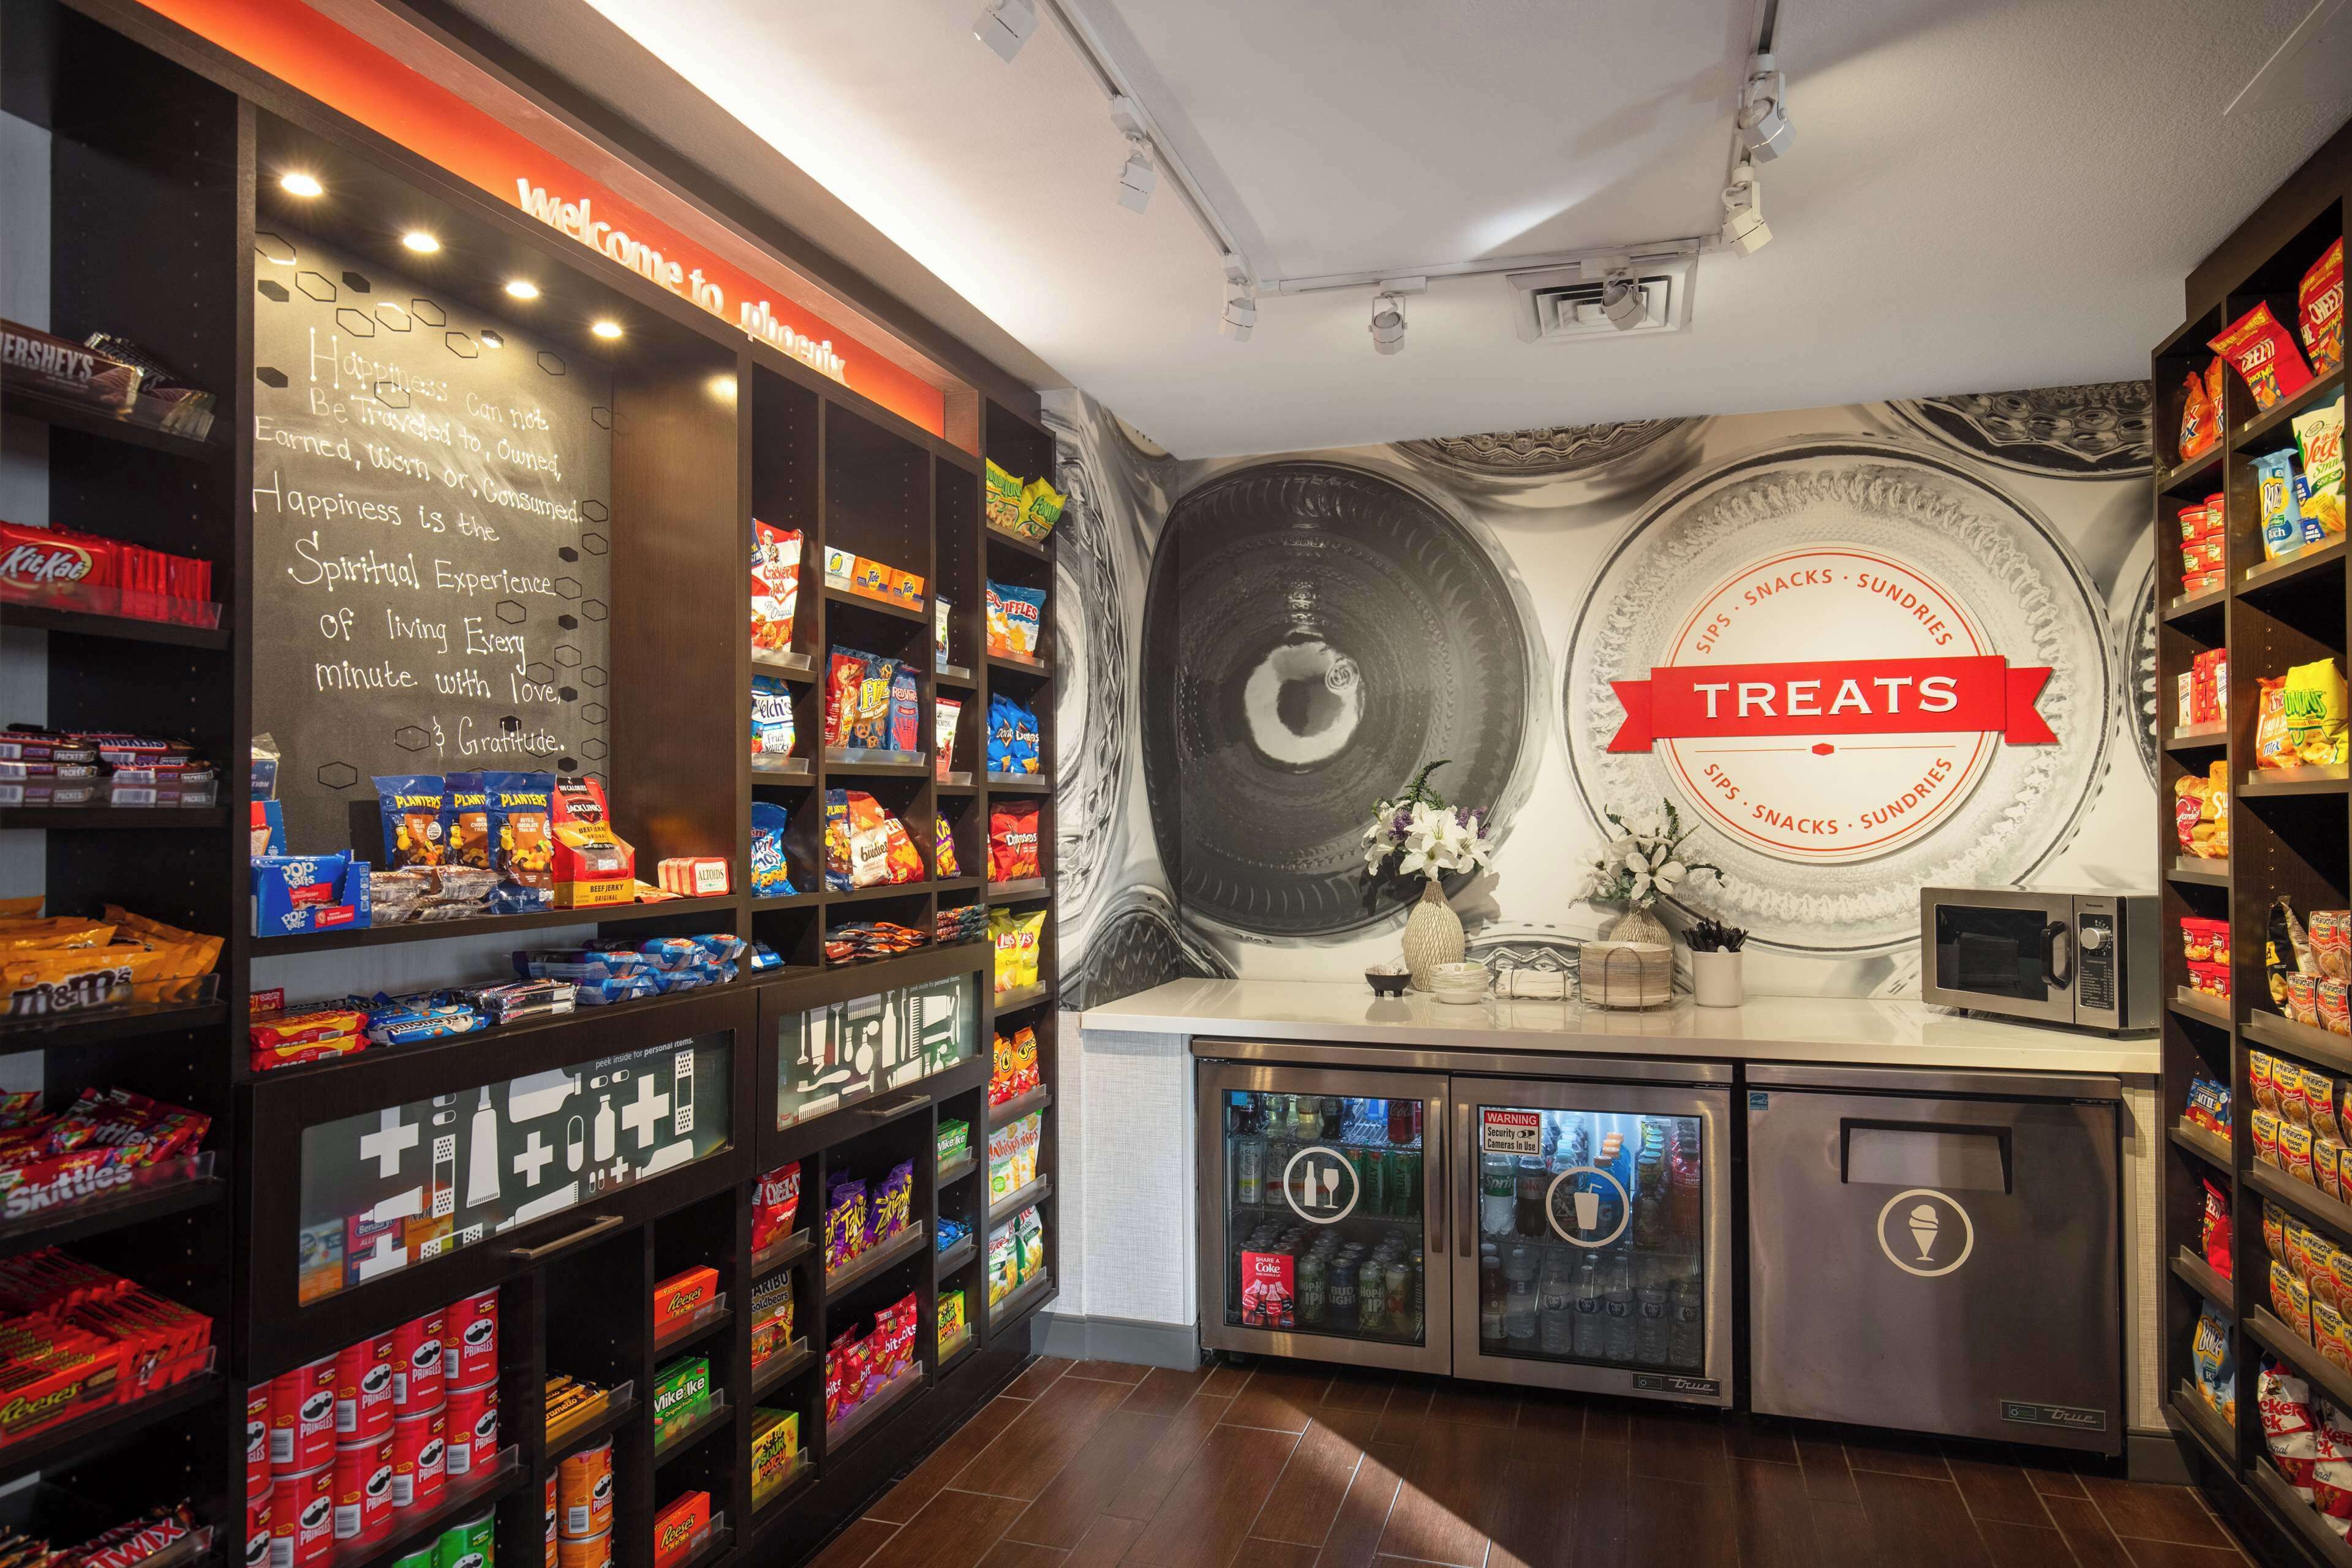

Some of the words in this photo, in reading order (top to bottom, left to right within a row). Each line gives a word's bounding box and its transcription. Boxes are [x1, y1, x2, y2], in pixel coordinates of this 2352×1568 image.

[688, 269, 724, 315] to
[741, 301, 850, 388] phoenix
[310, 327, 448, 402] Happiness
[310, 386, 348, 423] Be
[350, 394, 451, 445] Traveled
[255, 415, 361, 472] Earned,
[252, 470, 402, 526] Happiness
[419, 505, 447, 533] is
[459, 512, 500, 542] the
[287, 530, 420, 592] Spiritual
[435, 559, 557, 597] Experience
[830, 553, 843, 571] all
[865, 570, 880, 584] Tide
[902, 582, 914, 594] Tide
[1696, 612, 1732, 655] SIPS
[1743, 568, 1833, 606] SNACKS
[1856, 573, 1954, 647] SUNDRIES
[386, 609, 448, 655] living
[464, 616, 527, 676] Every
[316, 661, 418, 692] minute
[435, 669, 491, 698] with
[511, 673, 561, 704] love,
[1693, 676, 1959, 719] TREATS
[458, 716, 565, 755] Gratitude.
[767, 733, 785, 743] Fruit
[394, 794, 441, 810] PLANTERS
[500, 793, 547, 809] PLANTERS
[1703, 763, 1741, 800] SIPS
[1752, 804, 1839, 835] SNACKS
[1860, 757, 1953, 830] SUNDRIES
[697, 868, 724, 882] ALTOIDS
[590, 884, 605, 893] BEEF
[605, 883, 624, 892] JERKY
[594, 894, 618, 903] ORIGINAL
[595, 1057, 611, 1071] peek
[613, 1052, 632, 1064] inside
[644, 1041, 673, 1057] personal
[1487, 1112, 1537, 1125] WARNING
[1487, 1126, 1515, 1140] Security
[1487, 1138, 1515, 1150] Cameras
[1517, 1140, 1523, 1150] In
[1524, 1141, 1536, 1152] Use
[4, 1162, 134, 1219] Skittles
[1255, 1262, 1281, 1273] Coke
[667, 1286, 703, 1313] Reese's
[1329, 1294, 1356, 1306] LIGHT
[1331, 1285, 1355, 1295] BUD
[939, 1308, 956, 1327] SOUR
[464, 1337, 494, 1359] PRINGLES
[412, 1359, 442, 1384] PRINGLES
[362, 1385, 392, 1409] PRINGLES
[685, 1375, 706, 1398] Ike
[1668, 1378, 1714, 1392] true
[665, 1403, 682, 1417] Original
[2043, 1408, 2098, 1424] true
[300, 1414, 334, 1439] PRINGLES
[760, 1436, 785, 1467] SOUR
[418, 1458, 445, 1483] PRINGLES
[760, 1451, 786, 1479] PATCH
[366, 1490, 392, 1513] PRINGLES
[300, 1518, 331, 1547] PRINGLES
[660, 1513, 696, 1549] Reese's
